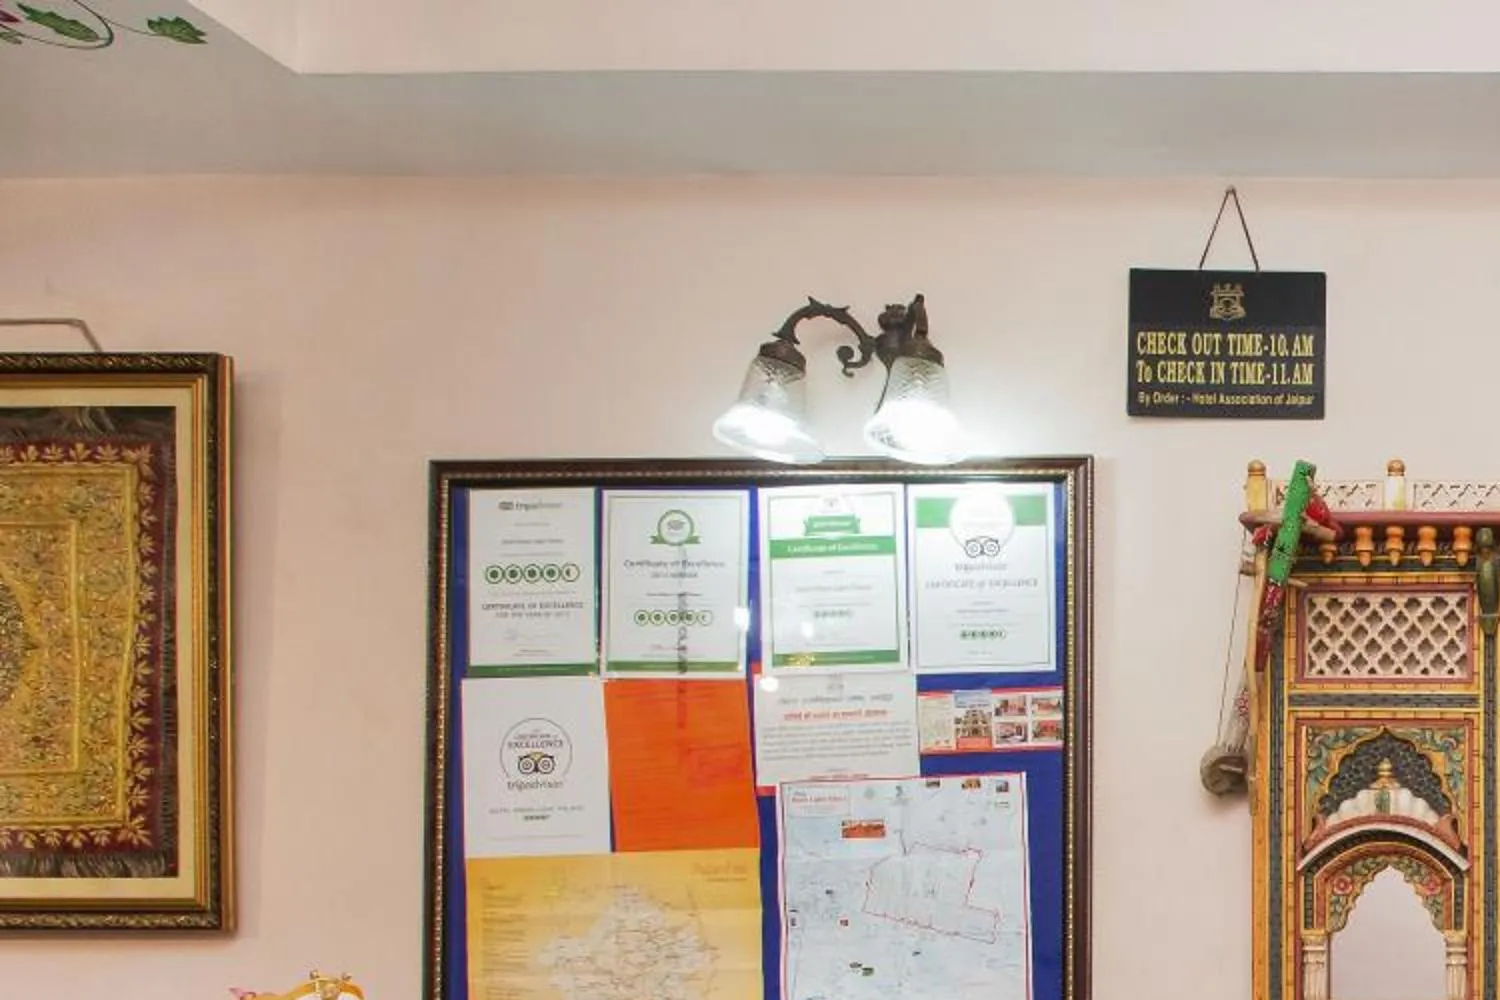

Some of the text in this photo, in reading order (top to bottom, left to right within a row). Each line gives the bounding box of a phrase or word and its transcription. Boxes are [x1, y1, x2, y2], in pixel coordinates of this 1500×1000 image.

[1136, 331, 1187, 356] CHECK
[1191, 332, 1223, 356] OUT
[1135, 359, 1153, 384] To
[1157, 361, 1206, 384] CHECK
[1209, 361, 1226, 385] IN
[1192, 392, 1217, 405] Hotel
[1218, 392, 1273, 405] Association
[1285, 393, 1315, 407] Jaipur
